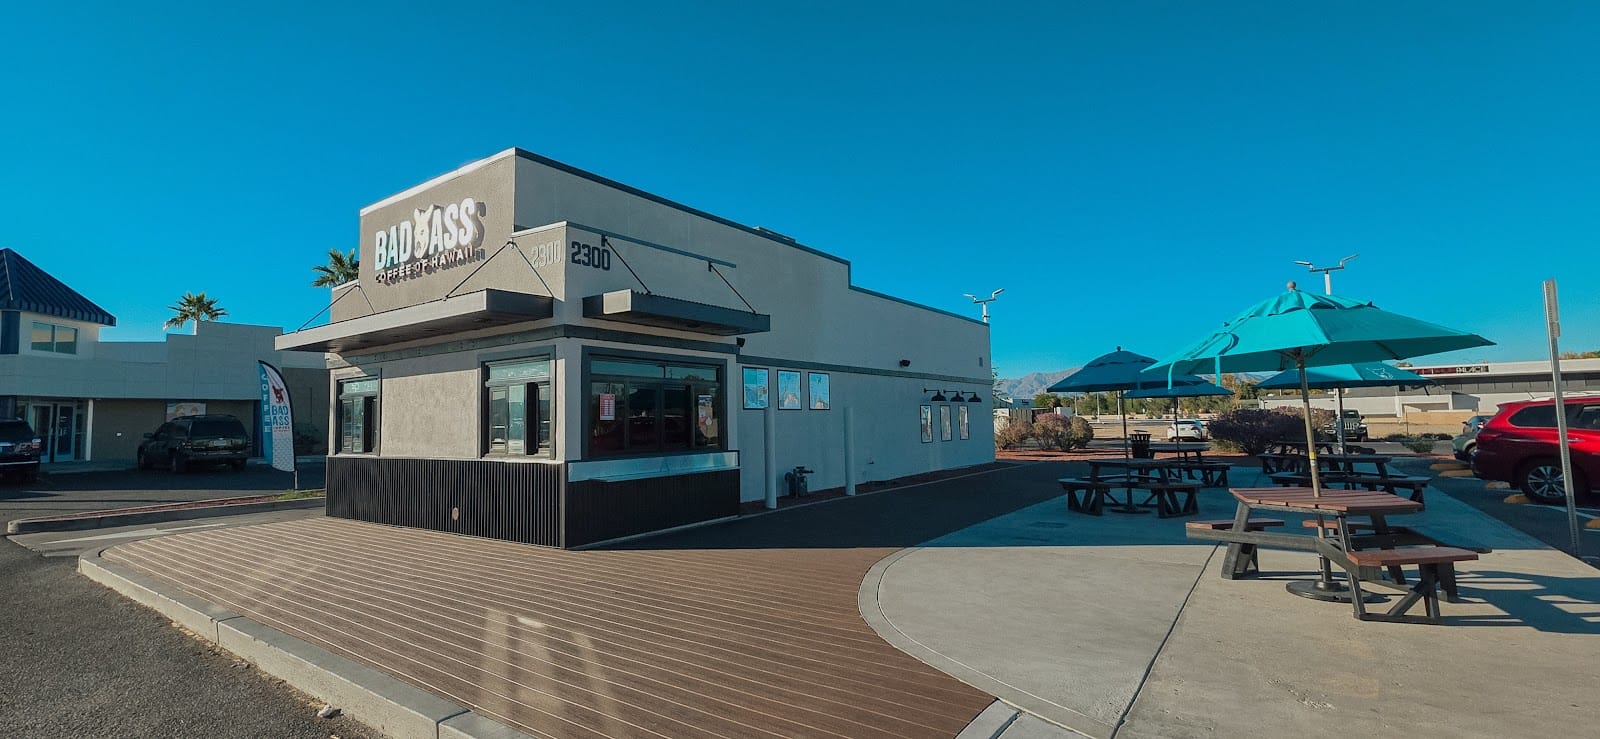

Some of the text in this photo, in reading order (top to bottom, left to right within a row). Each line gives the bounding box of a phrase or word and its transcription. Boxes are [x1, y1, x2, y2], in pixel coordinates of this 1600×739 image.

[375, 198, 475, 271] BAD ASS
[376, 243, 474, 284] COFFEE OF HAWAII
[530, 240, 562, 268] 2300
[572, 241, 611, 271] 2300
[261, 373, 272, 433] COFFEE
[272, 405, 289, 415] BAD
[273, 416, 290, 426] ASS
